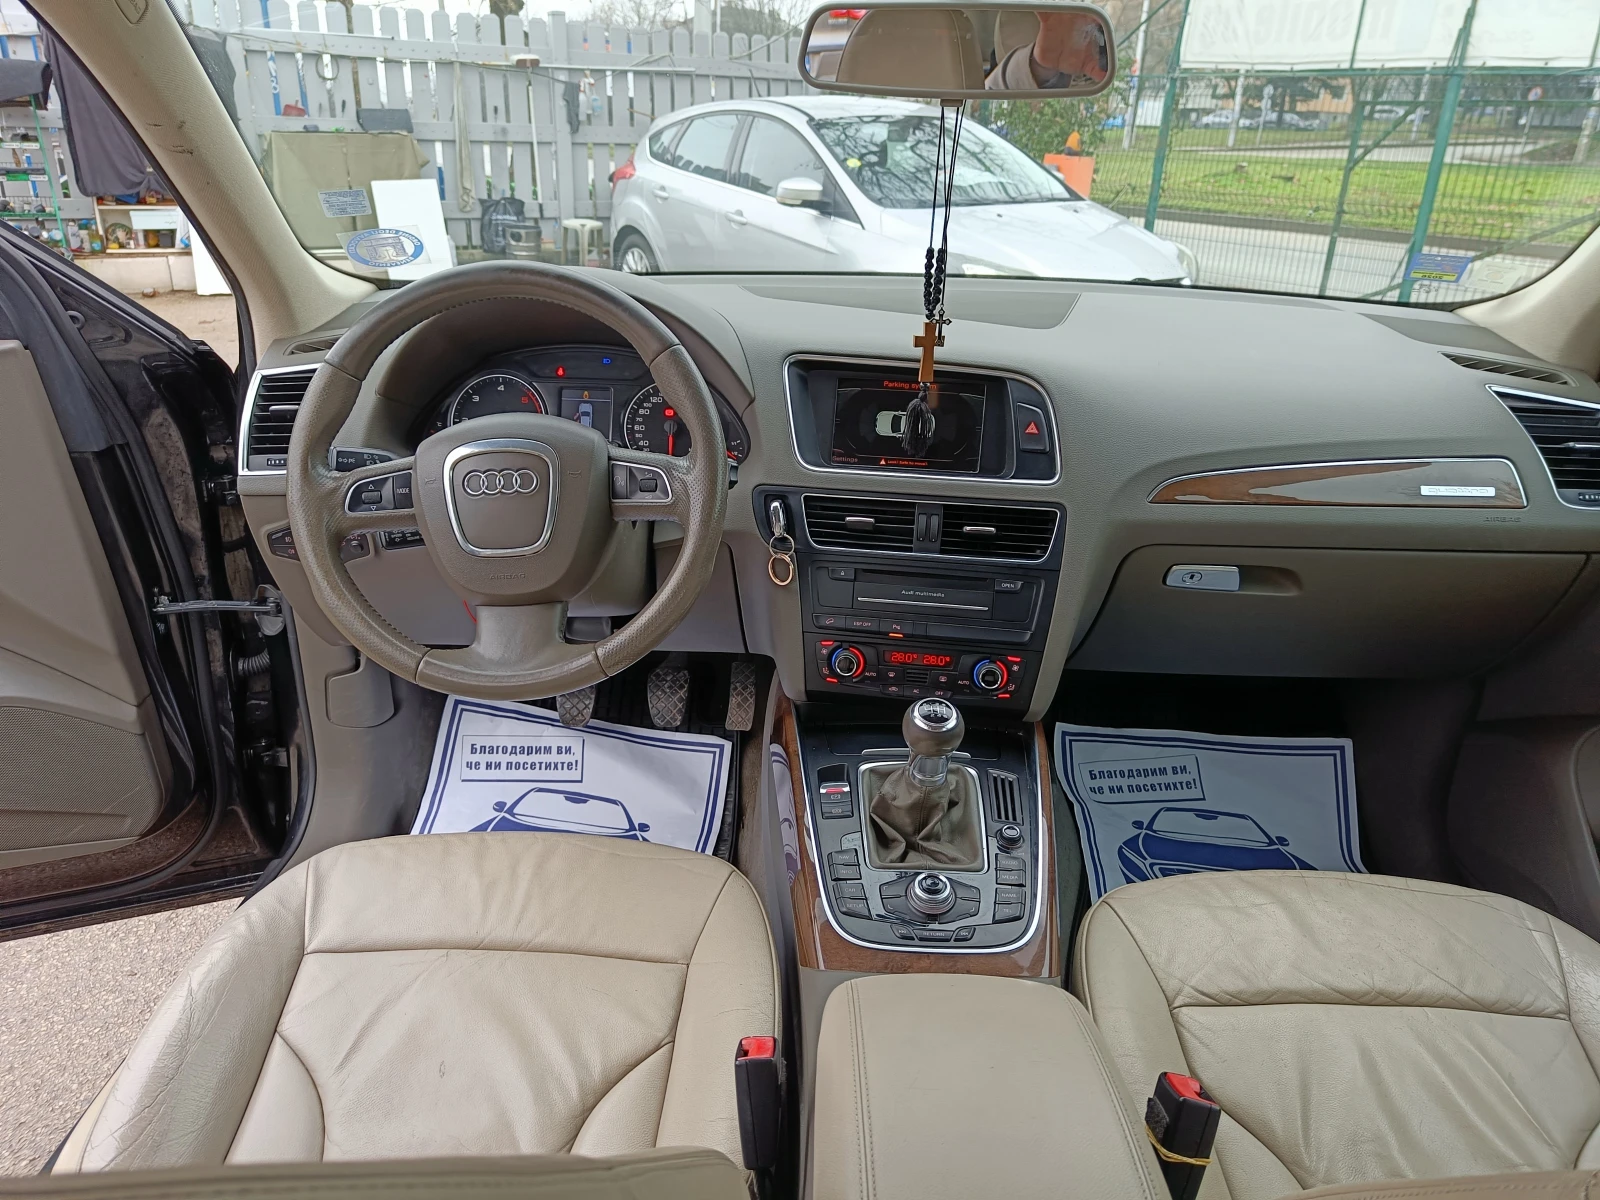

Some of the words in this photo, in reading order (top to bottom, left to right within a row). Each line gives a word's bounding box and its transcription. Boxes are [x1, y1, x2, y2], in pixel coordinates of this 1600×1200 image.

[883, 380, 910, 389] Parking
[521, 396, 529, 404] 5
[832, 455, 859, 463] Settings
[1428, 487, 1489, 495] quattro
[489, 572, 526, 580] AIRBAG
[469, 742, 553, 757] Благодарим
[556, 745, 576, 757] ви,
[465, 760, 481, 771] че
[485, 760, 502, 771] ни
[505, 759, 579, 771] посетихте!
[1088, 766, 1168, 780] Благодарим
[1171, 764, 1192, 776] ви,
[1088, 785, 1105, 795] че
[1108, 784, 1125, 795] ни
[1127, 778, 1198, 794] посетихте!
